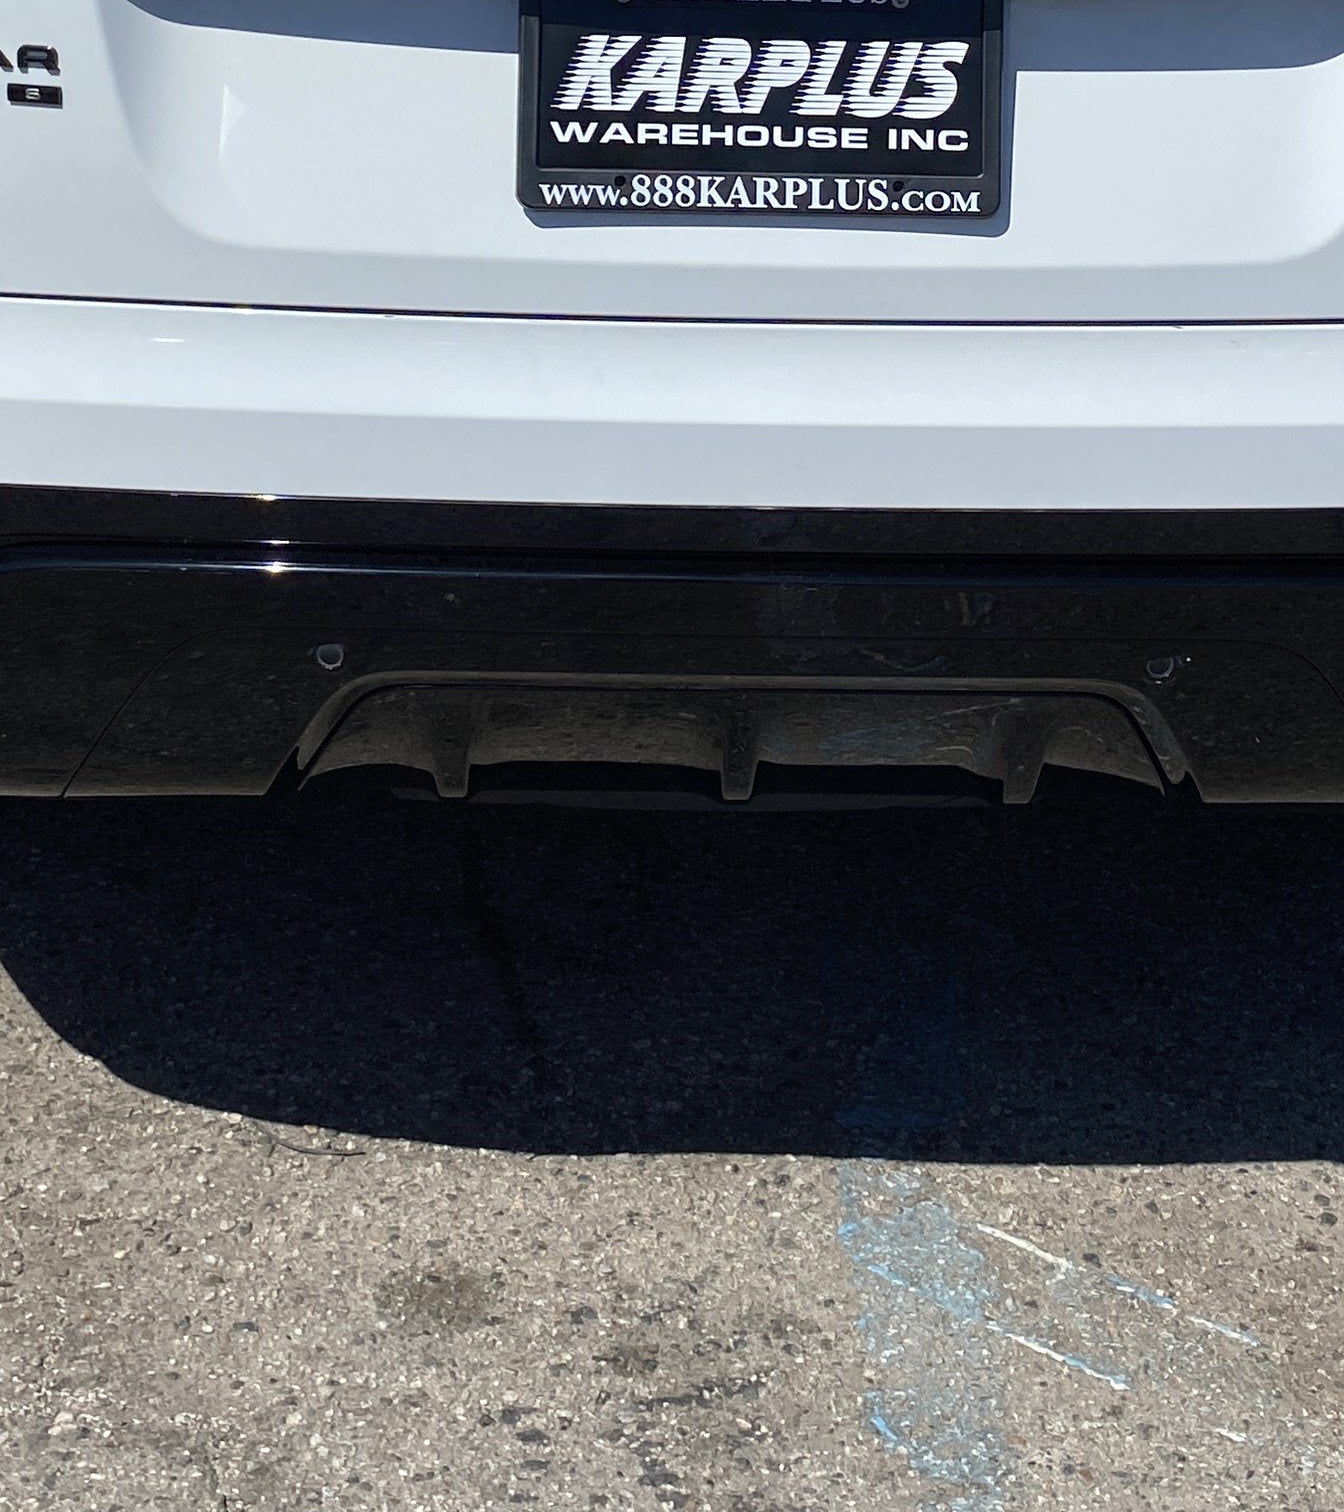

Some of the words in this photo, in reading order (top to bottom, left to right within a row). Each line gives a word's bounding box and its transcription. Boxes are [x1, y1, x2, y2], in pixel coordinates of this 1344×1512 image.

[550, 34, 971, 120] KARPLUS
[550, 121, 869, 150] WAREHOUSE
[887, 128, 970, 152] INC
